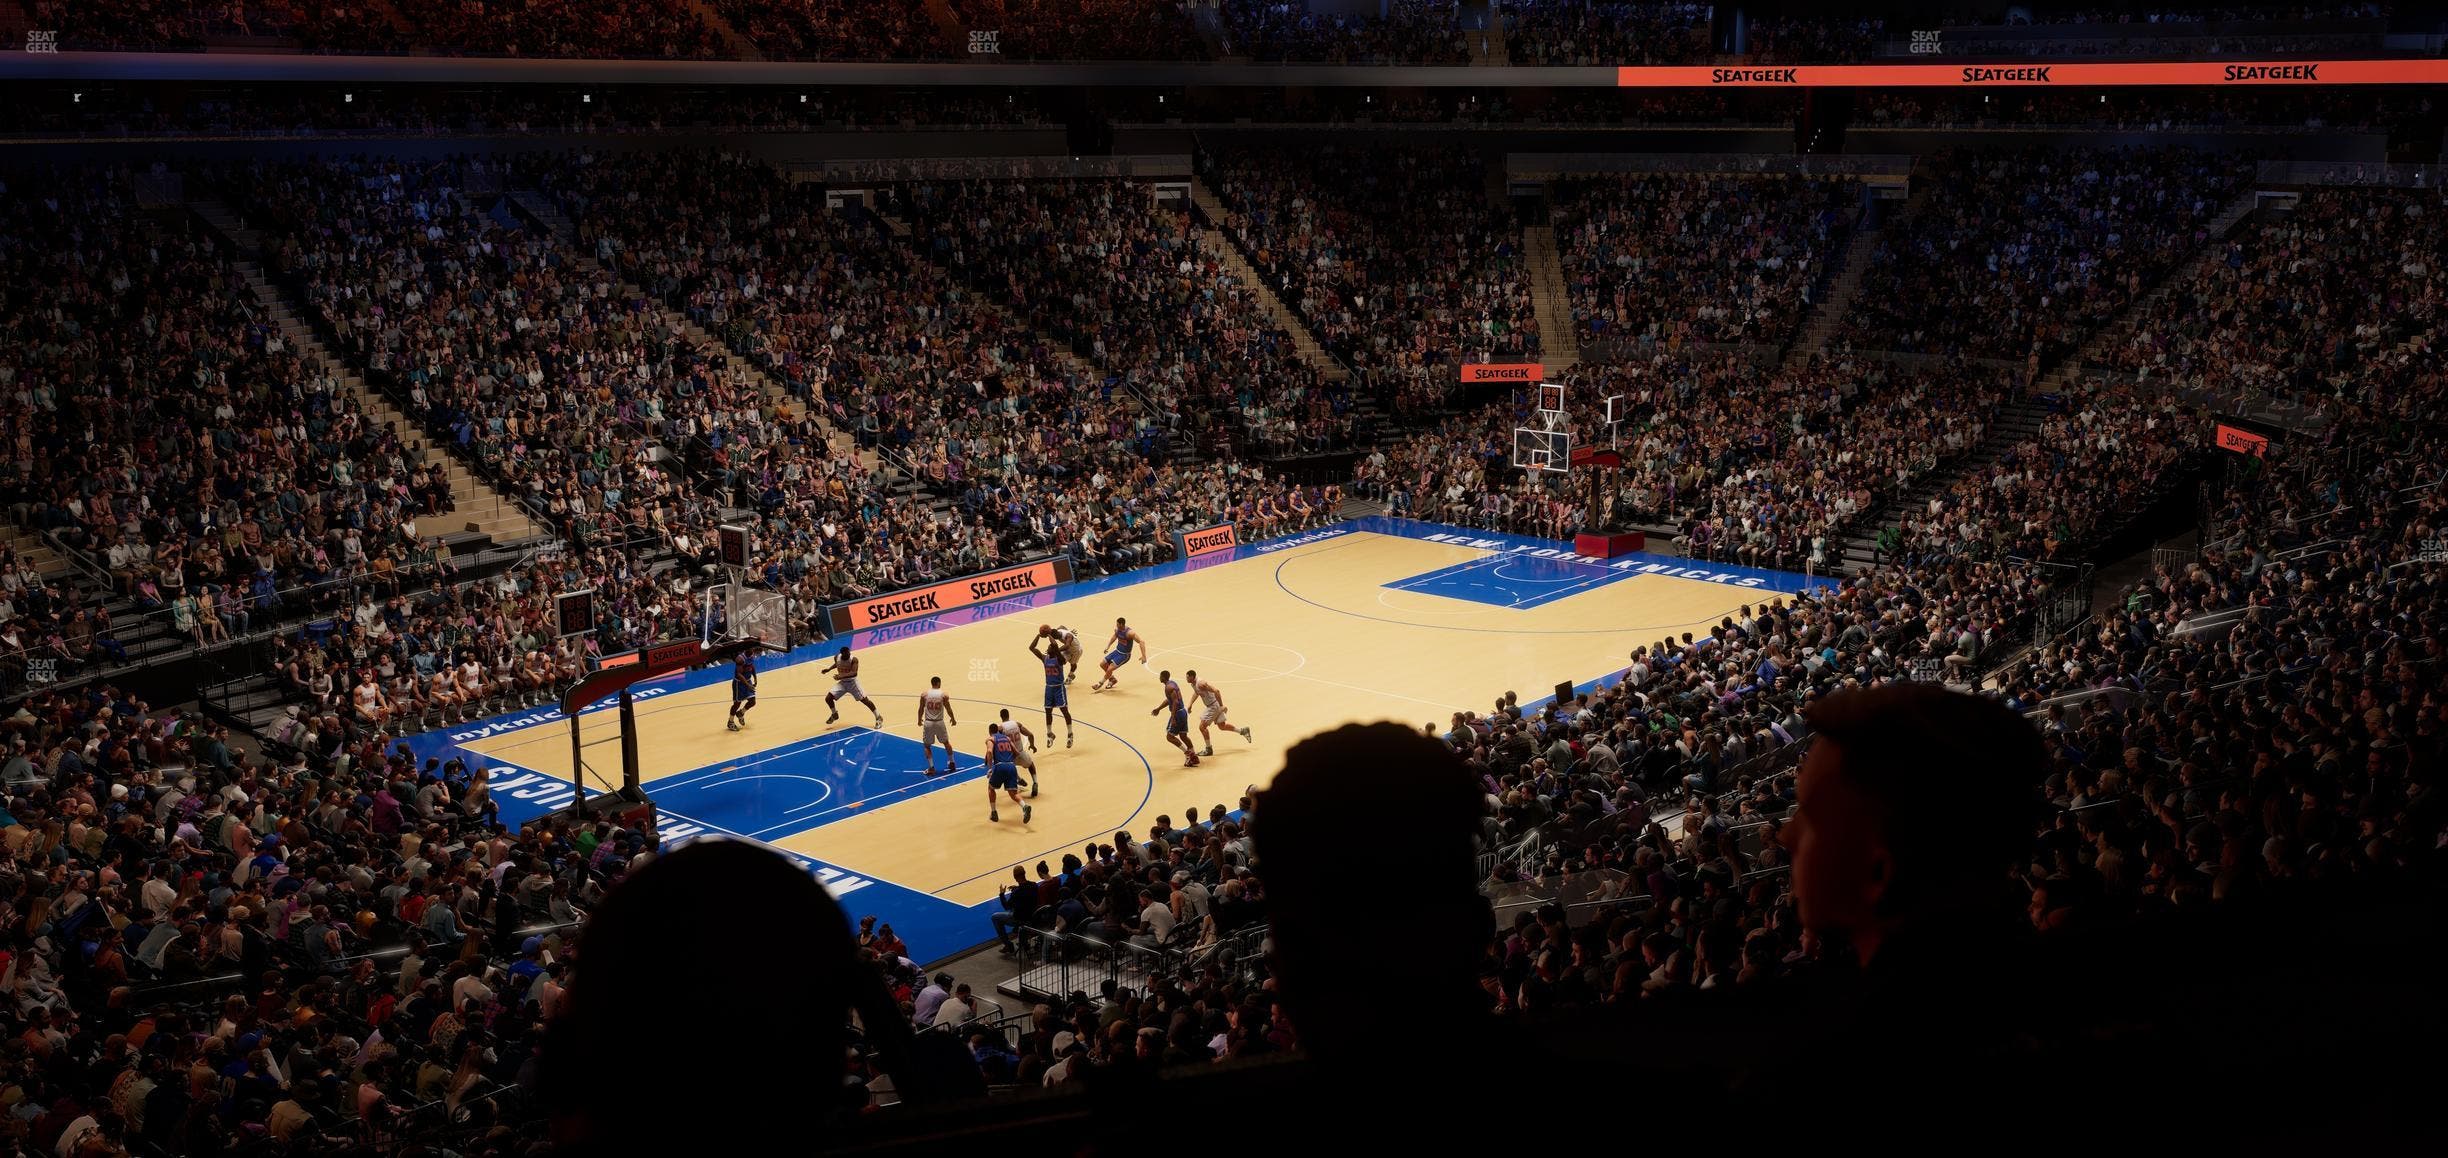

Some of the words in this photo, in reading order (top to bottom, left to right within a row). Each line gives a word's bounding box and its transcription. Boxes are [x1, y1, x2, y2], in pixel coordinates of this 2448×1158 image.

[1712, 68, 1797, 83] SEATGEEK
[1962, 67, 2050, 82] SEATGEEK
[2225, 64, 2319, 80] SEATGEEK
[1475, 368, 1529, 379] SEATGEEK
[1188, 530, 1232, 552] SEATGEEK
[1422, 533, 1505, 548] NEW
[1610, 560, 1766, 586] KNICKS
[970, 570, 1036, 600] SEATGEEK
[868, 592, 940, 623] SEATGEEK
[653, 644, 695, 663] SEATGEEK
